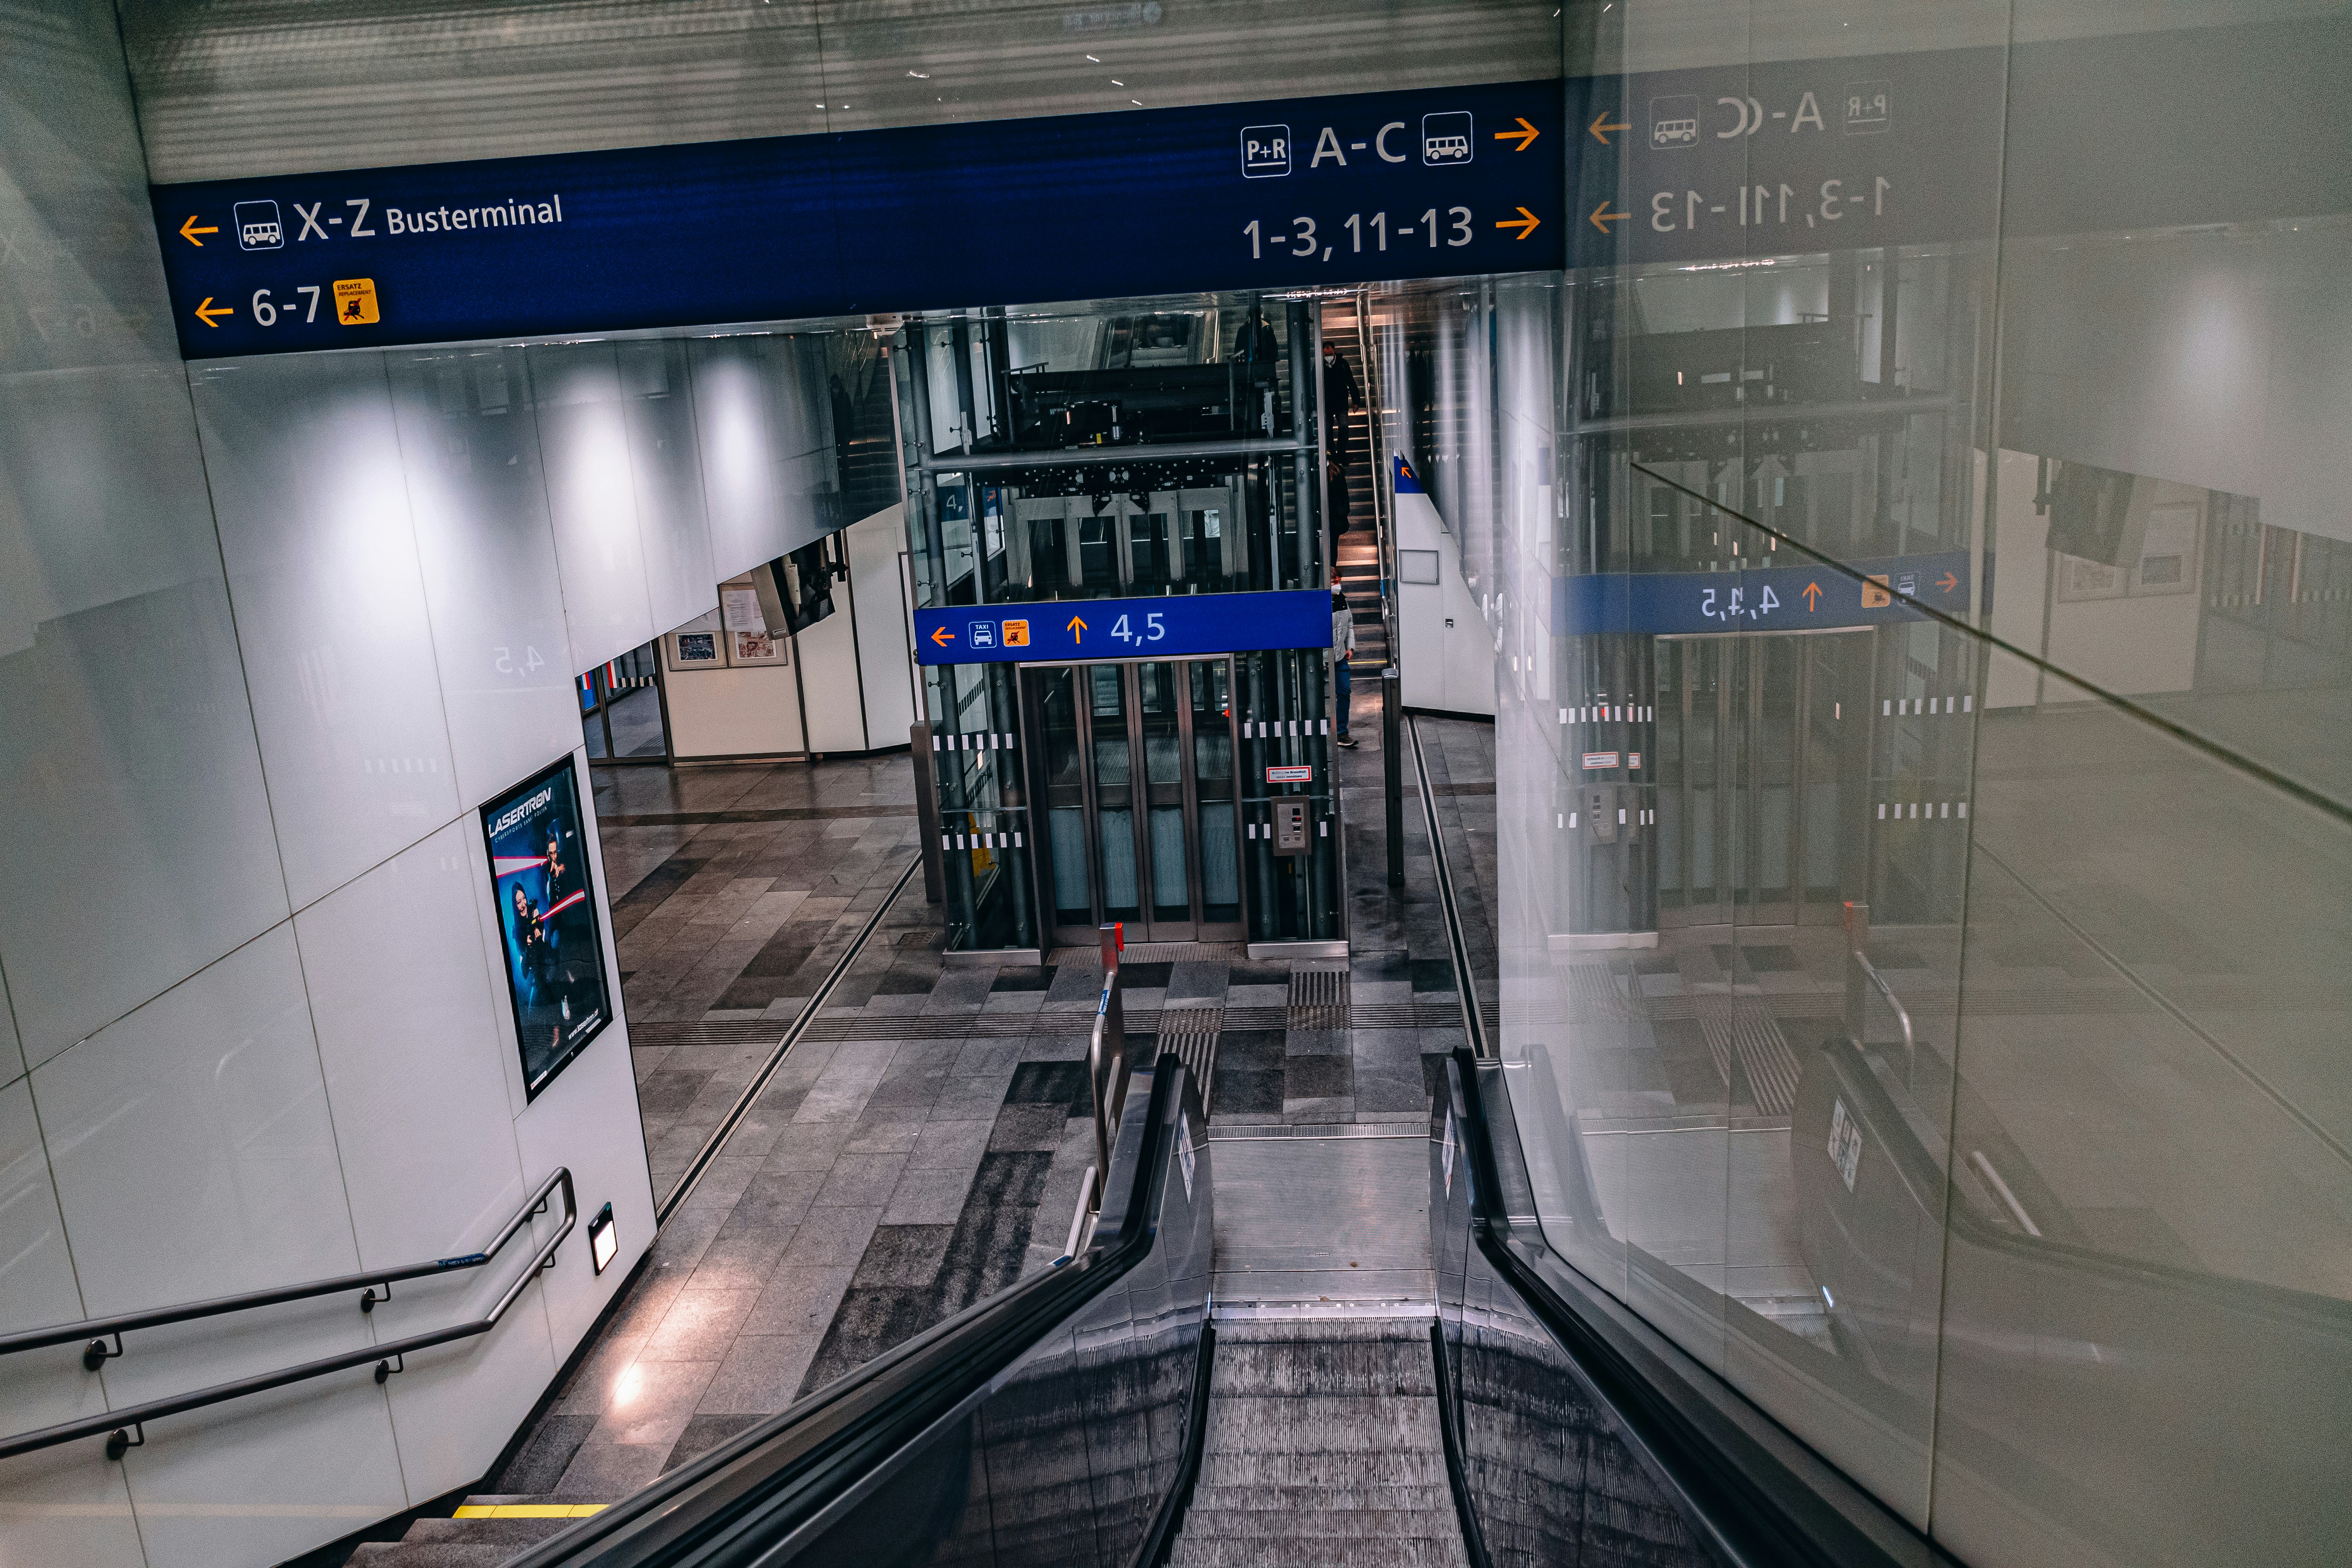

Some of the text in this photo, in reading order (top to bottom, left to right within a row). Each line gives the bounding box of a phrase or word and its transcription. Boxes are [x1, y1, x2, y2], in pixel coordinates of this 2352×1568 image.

[1247, 122, 1406, 168] P+R A-C
[293, 194, 562, 241] X-Z Busterminal
[252, 286, 320, 326] 6-7
[1111, 613, 1165, 646] 4,5
[488, 787, 551, 838] LASERTRON
